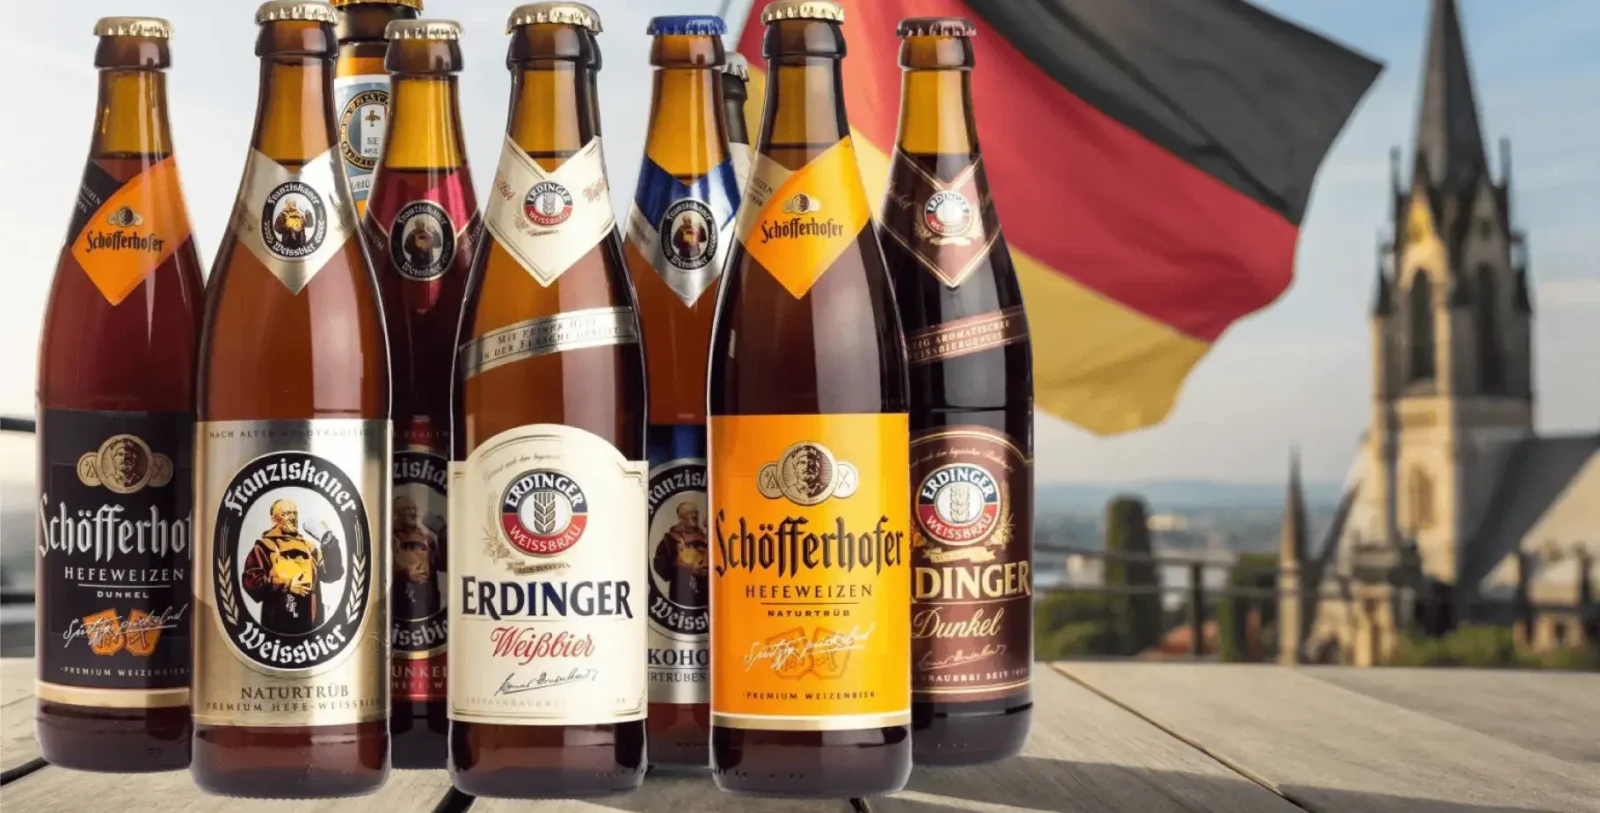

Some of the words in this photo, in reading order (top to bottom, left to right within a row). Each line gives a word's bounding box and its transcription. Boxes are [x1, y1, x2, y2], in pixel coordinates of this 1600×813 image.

[86, 229, 165, 253] Schöfferhofer
[761, 217, 843, 244] Schöfferhofer
[224, 457, 358, 517] Franziskaner
[505, 472, 585, 509] ERDINGER
[921, 466, 997, 500] ERDINGER
[714, 508, 904, 579] Schöfferhofer
[64, 566, 184, 582] HEFEWEIZEN
[97, 590, 149, 599] DUNKEL
[461, 576, 633, 621] ERDINGER
[745, 584, 873, 599] HEFEWEIZEN
[768, 609, 851, 617] NATURTRÜB
[911, 606, 1005, 639] Dunkel
[238, 621, 346, 664] Weissbier
[490, 626, 596, 666] Weißbier
[64, 666, 111, 676] PREMIUM
[241, 683, 349, 700] NATURTRÜB
[746, 692, 799, 700] PREMIUM
[805, 690, 876, 700] WEIZENBIER
[206, 702, 263, 712] PREMIUM
